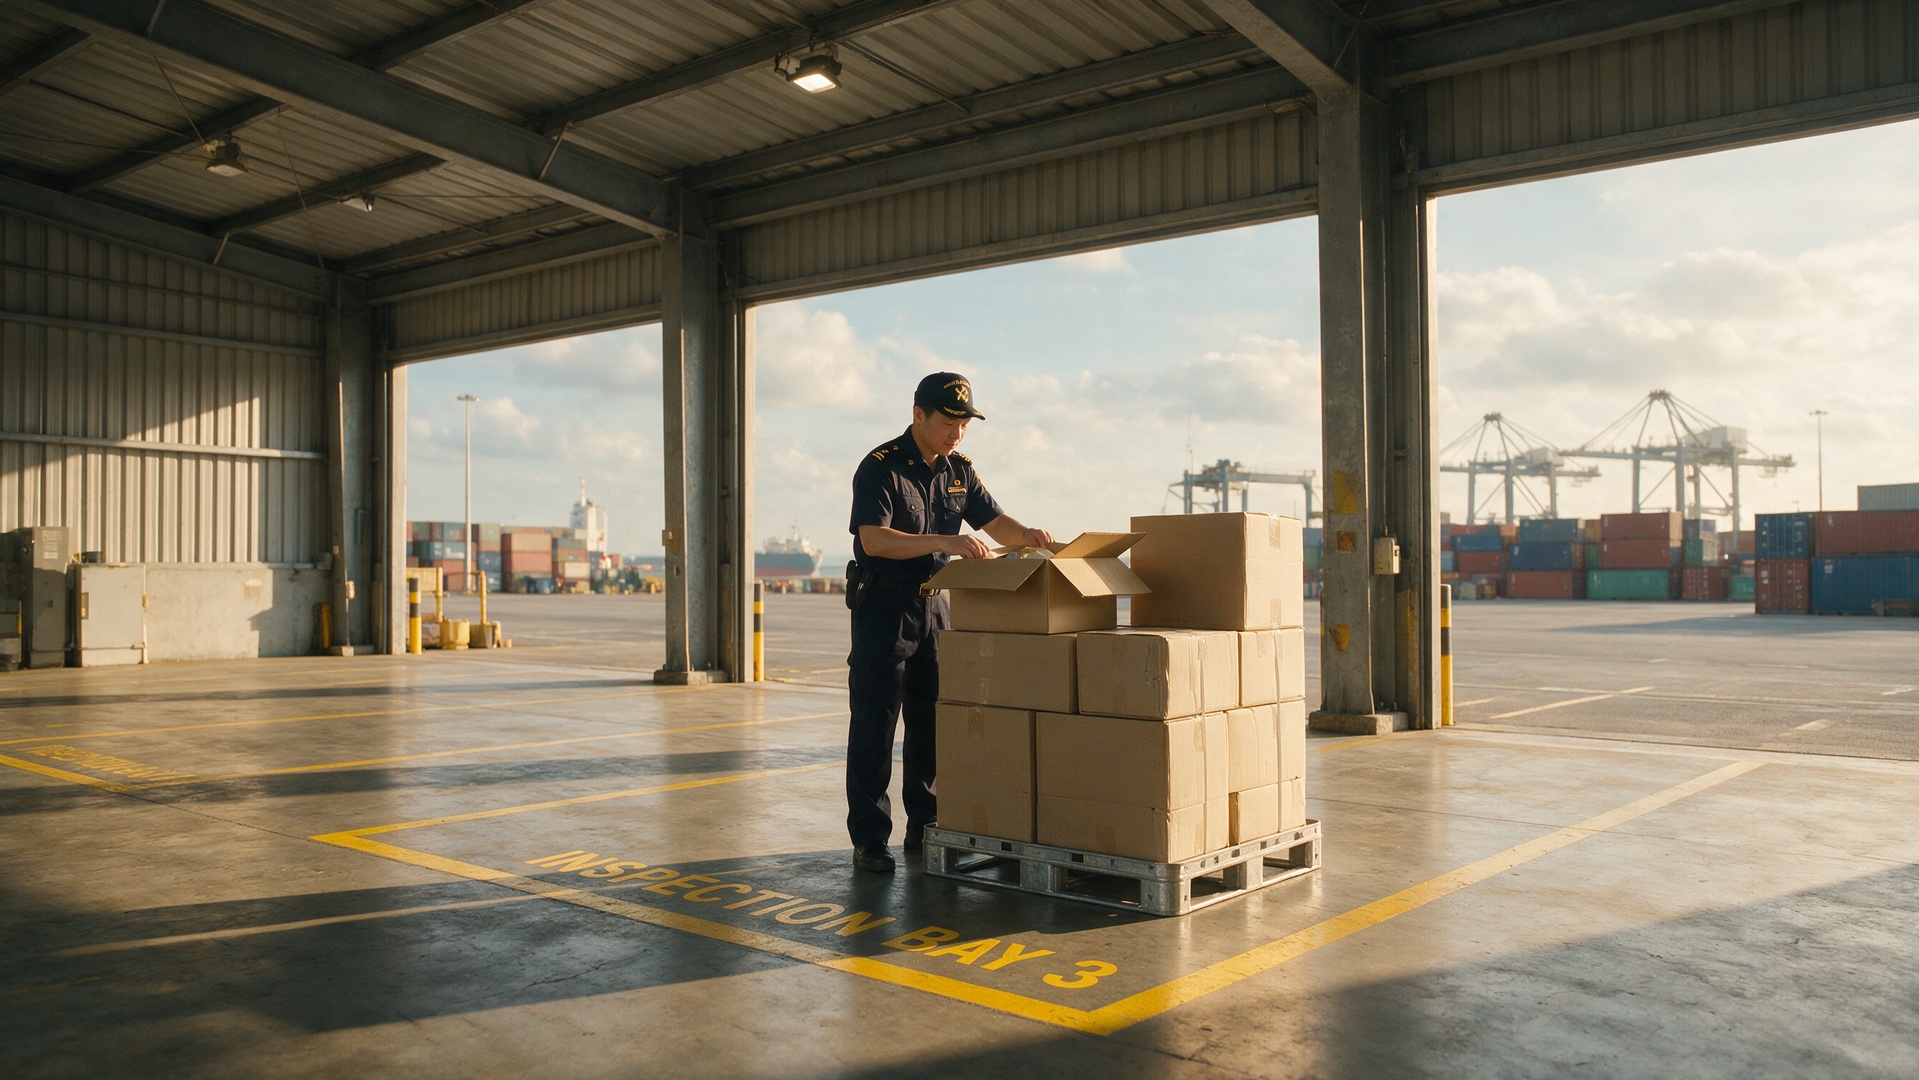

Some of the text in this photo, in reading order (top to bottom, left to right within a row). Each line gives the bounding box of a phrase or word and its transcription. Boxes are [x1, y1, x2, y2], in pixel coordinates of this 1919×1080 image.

[525, 850, 1118, 989] INSPECTION BAY 3
